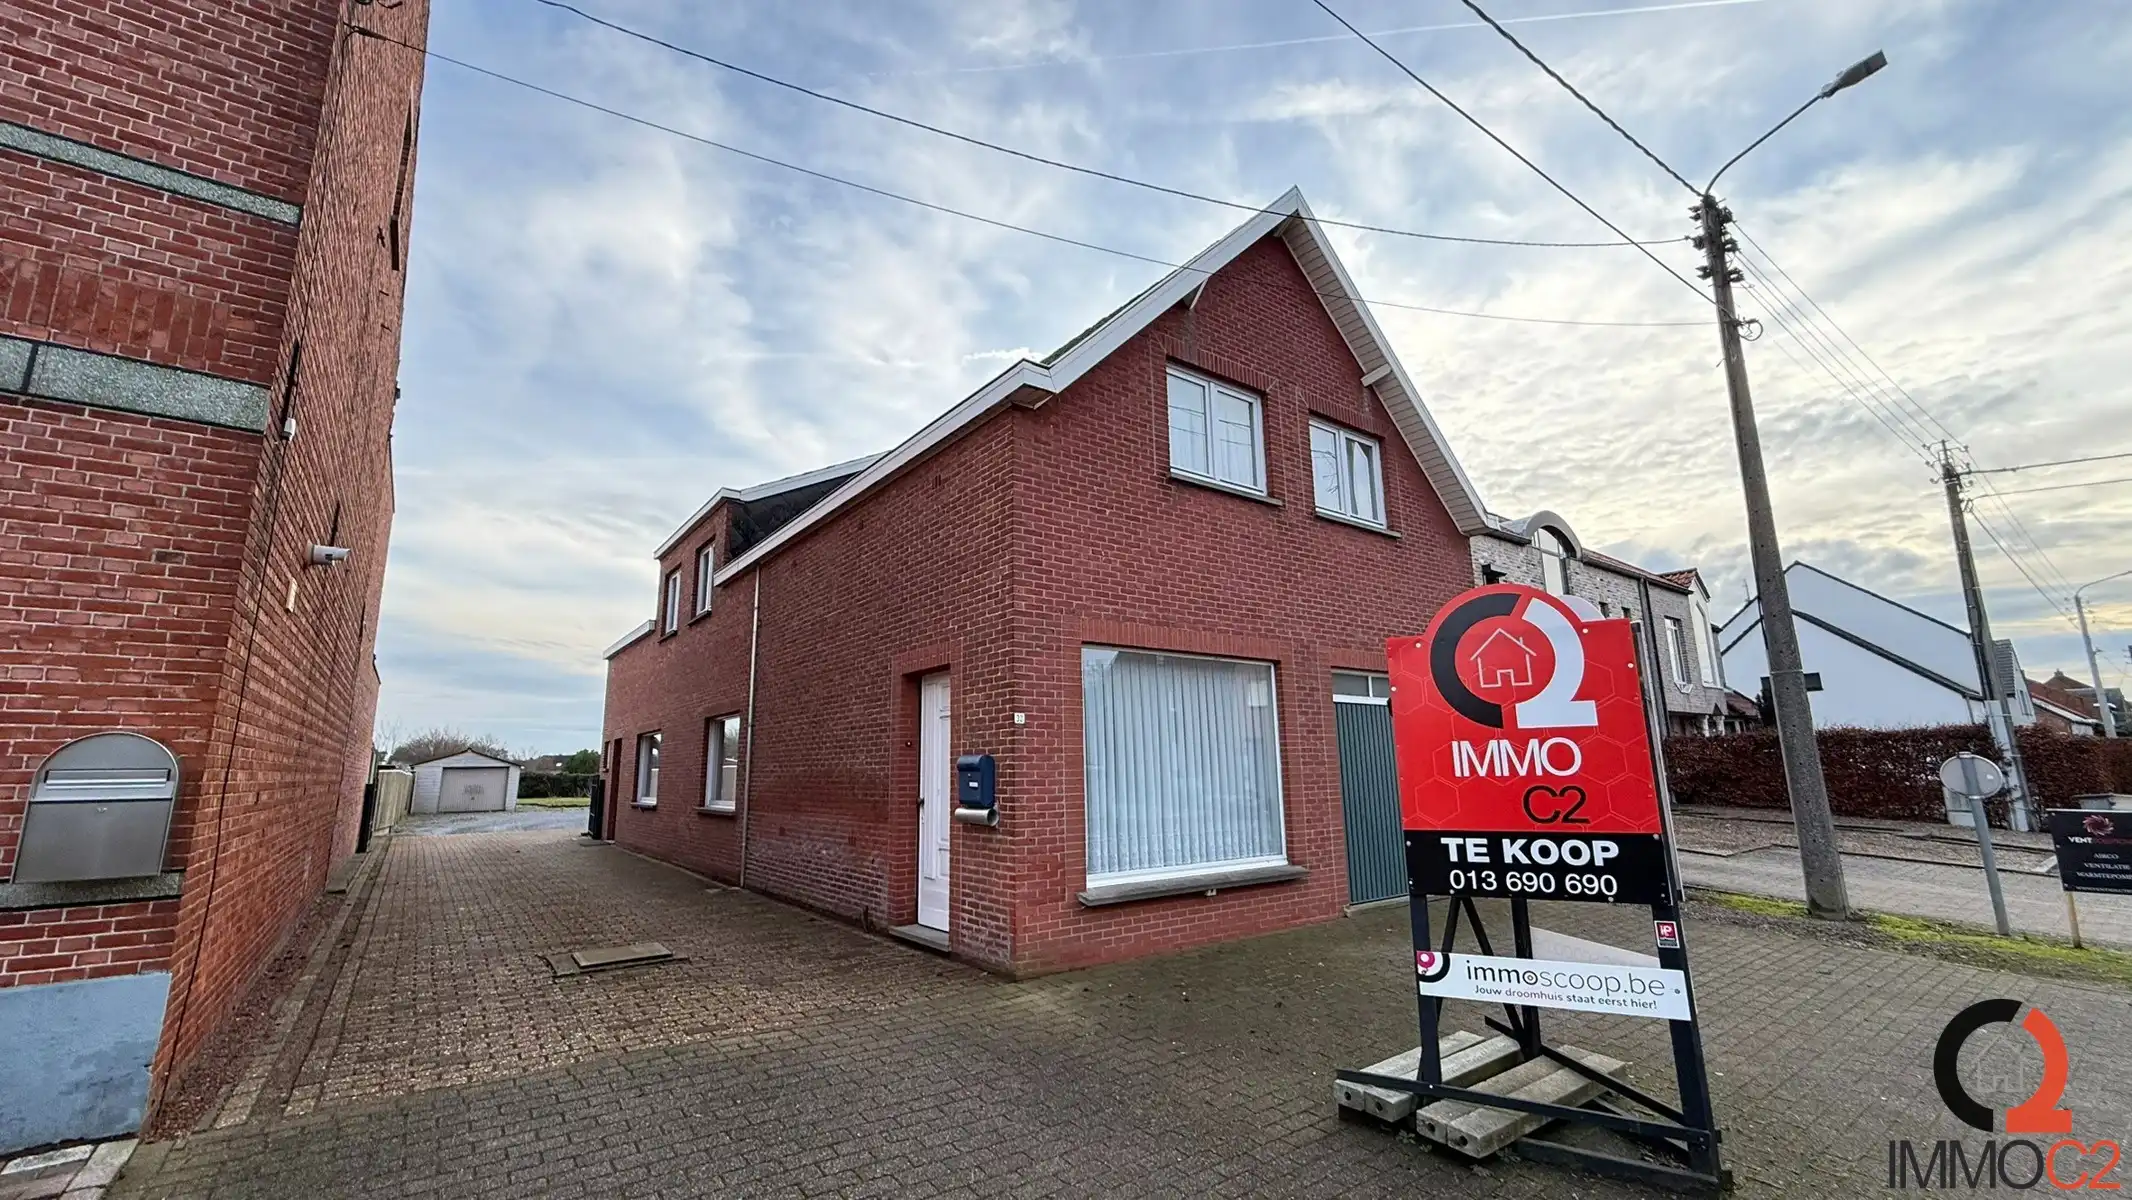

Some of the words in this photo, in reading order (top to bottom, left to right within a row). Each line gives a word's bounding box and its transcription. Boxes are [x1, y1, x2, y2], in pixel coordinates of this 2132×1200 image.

[1451, 736, 1582, 777] IMMO
[1522, 784, 1591, 825] C2
[1440, 837, 1490, 863] TE
[1501, 838, 1619, 867] KOOP
[1449, 869, 1497, 891] 013
[1505, 871, 1556, 893] 690
[1564, 873, 1618, 896] 690
[1466, 960, 1665, 997] immoscoop.be
[1475, 985, 1502, 995] Jouw
[1505, 988, 1563, 1001] droomhuis
[1566, 994, 1595, 1004] staat
[1598, 997, 1627, 1007] eerst
[1631, 998, 1657, 1009] hier!
